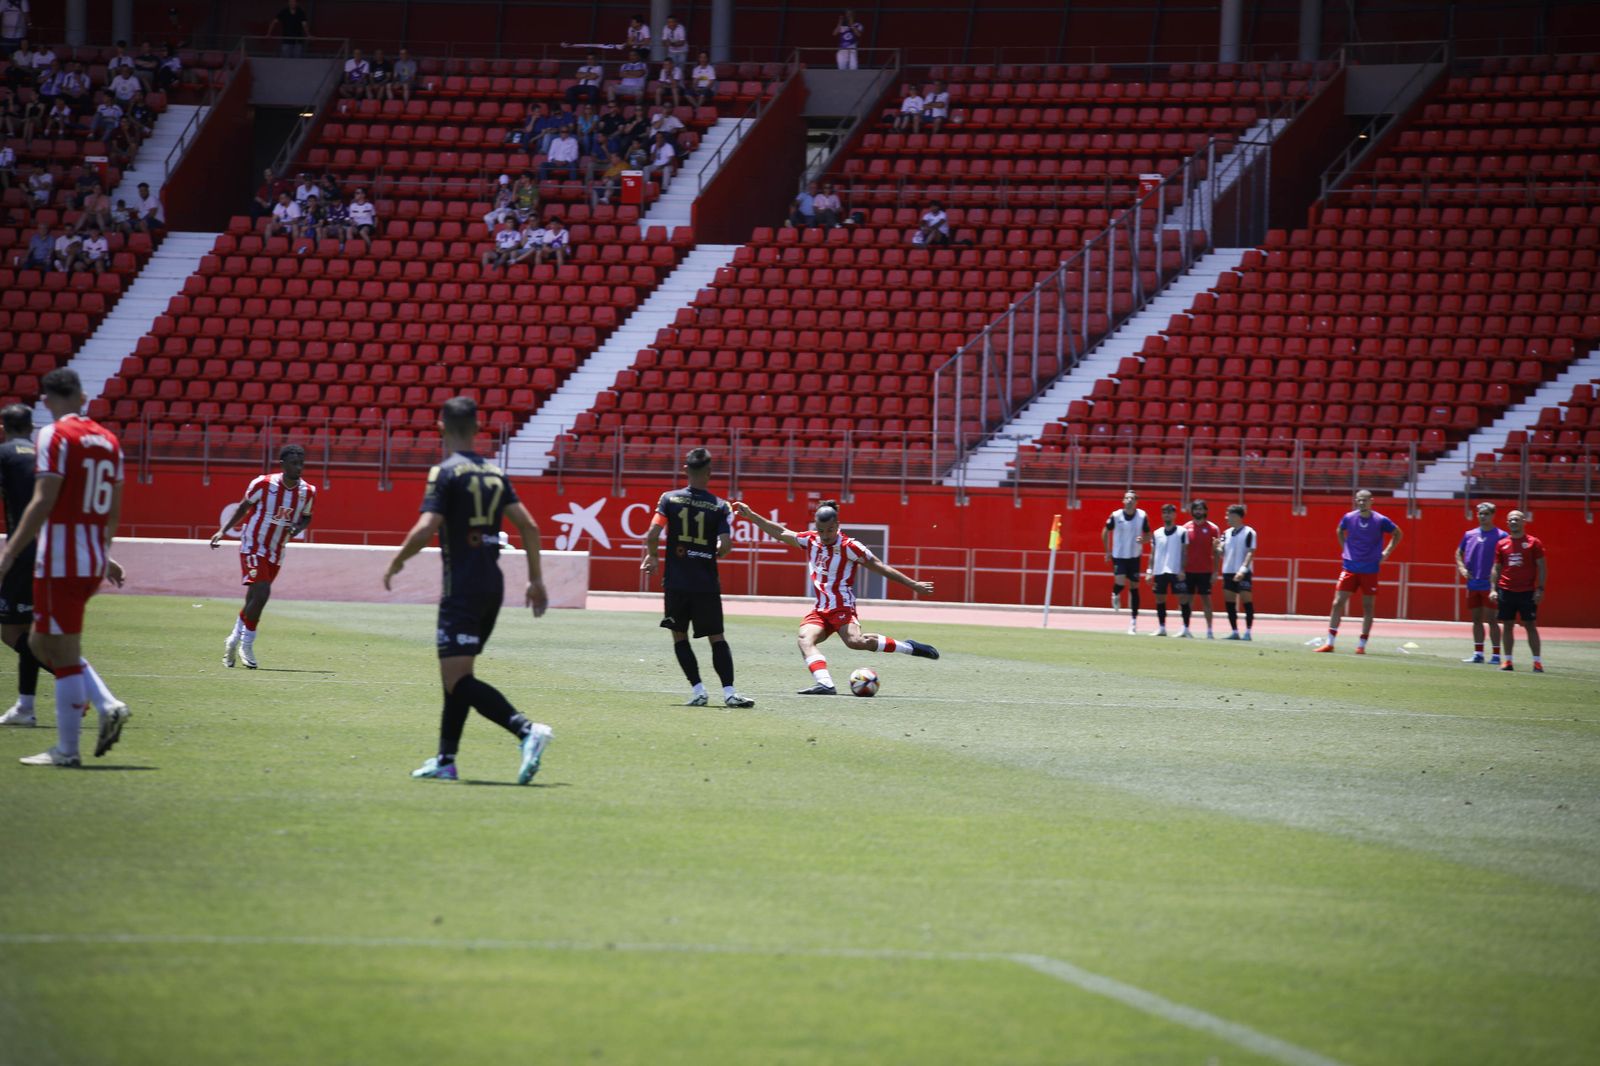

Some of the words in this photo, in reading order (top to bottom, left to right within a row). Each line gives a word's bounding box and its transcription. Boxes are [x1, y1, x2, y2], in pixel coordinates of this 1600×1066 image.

[82, 458, 114, 515] 16
[467, 475, 504, 526] 17
[677, 506, 708, 546] 11
